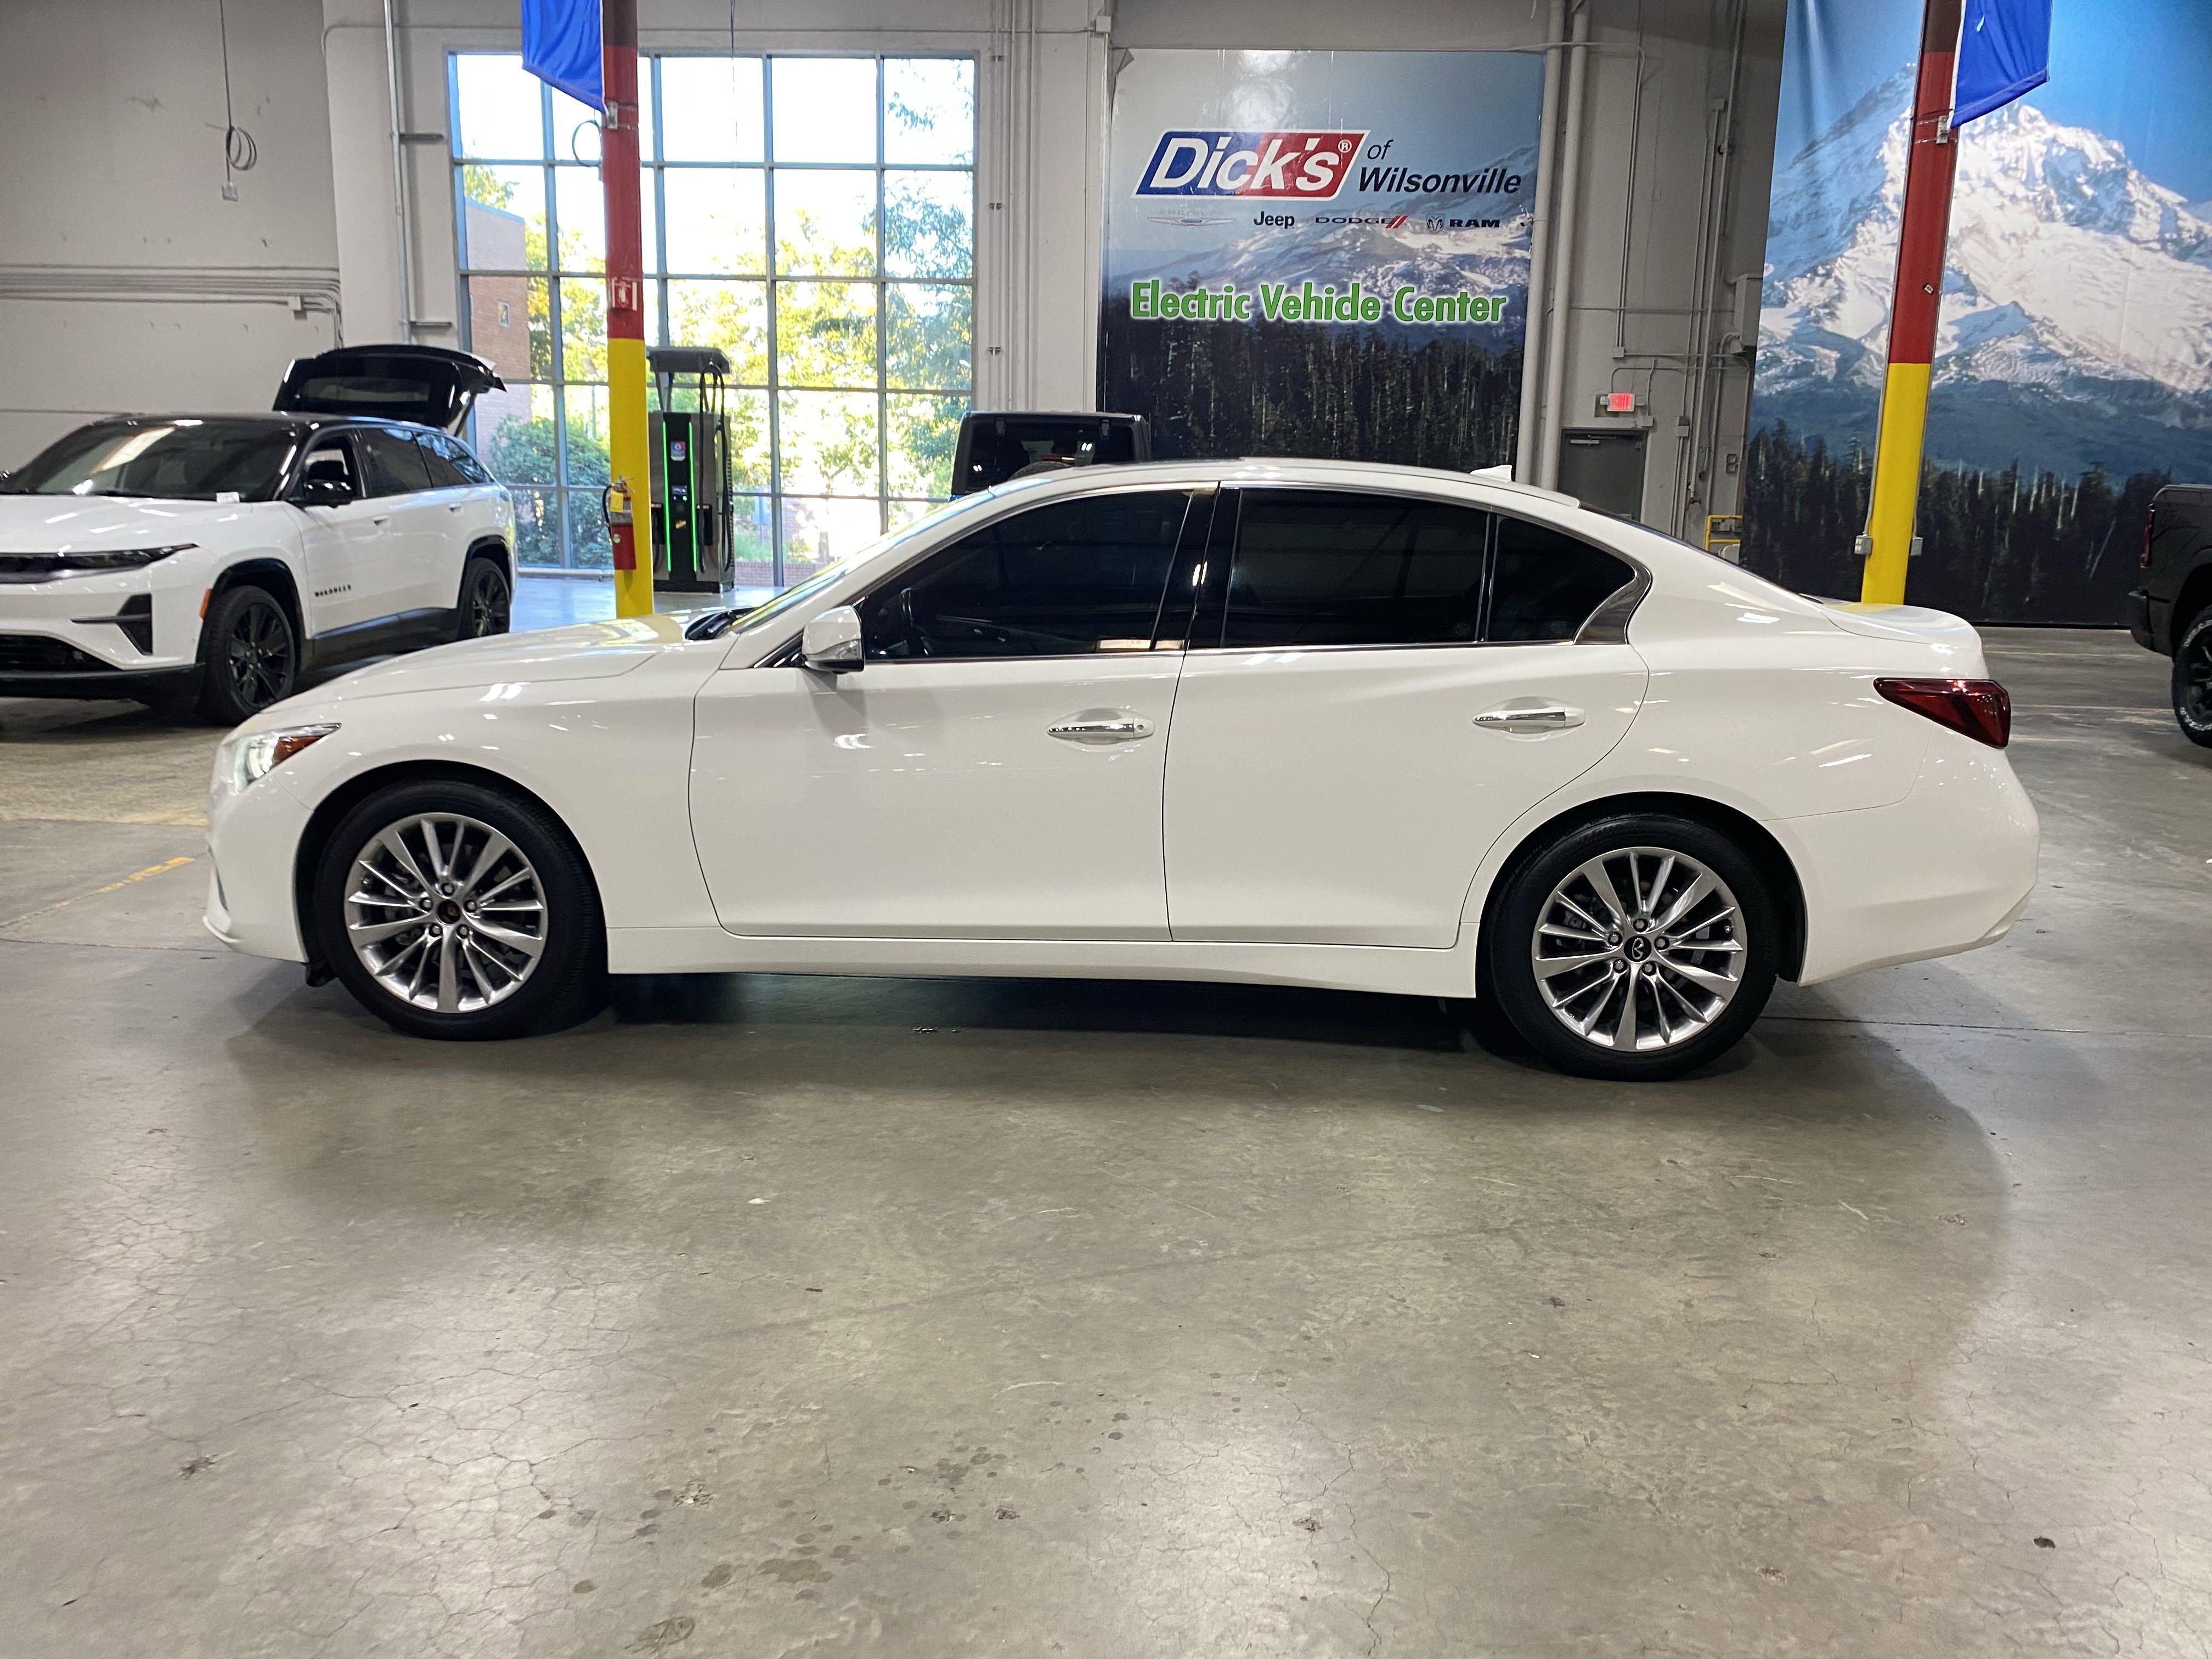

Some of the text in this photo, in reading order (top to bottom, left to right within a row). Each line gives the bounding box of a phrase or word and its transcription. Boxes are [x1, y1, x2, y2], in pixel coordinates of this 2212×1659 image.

[1367, 139, 1395, 160] of
[1358, 167, 1522, 194] Wilsonville
[1253, 211, 1295, 229] Jeep
[1449, 219, 1500, 228] RAM
[1132, 279, 1507, 321] Electric Vehicle Center
